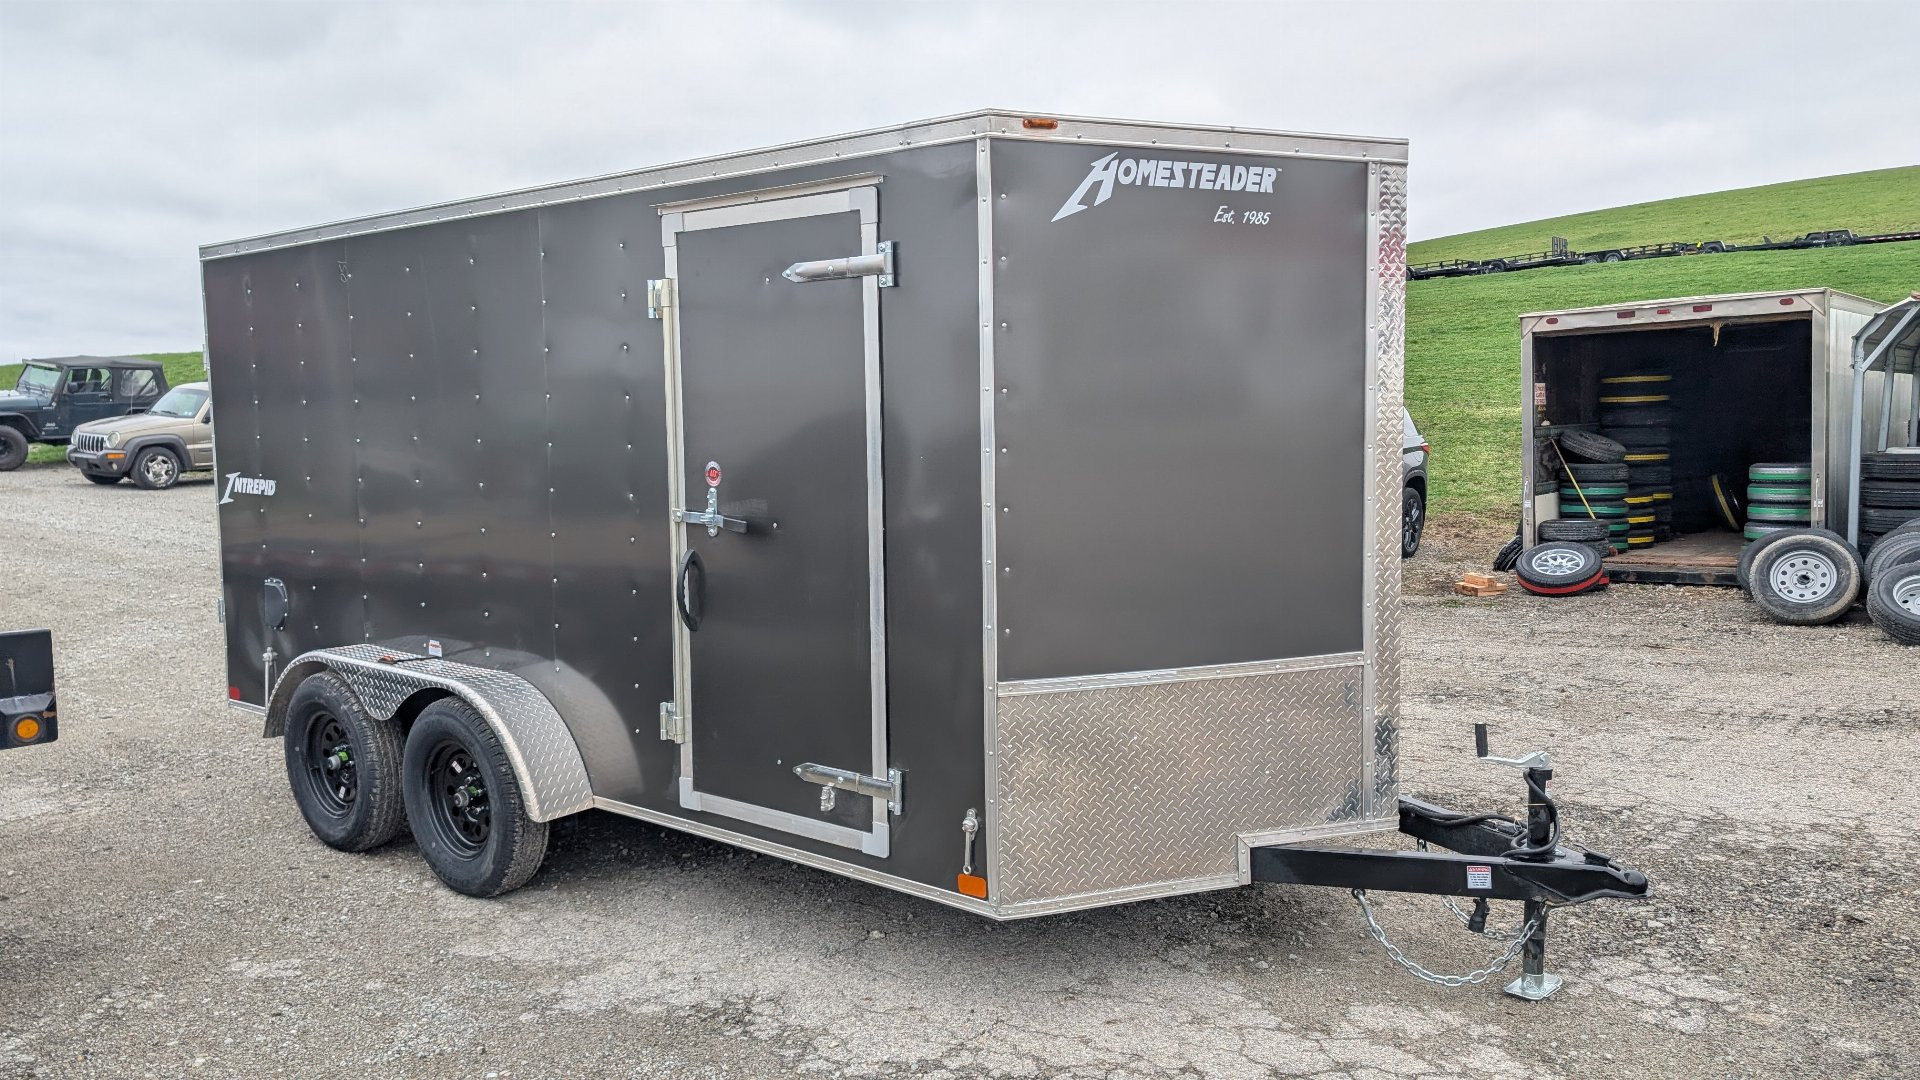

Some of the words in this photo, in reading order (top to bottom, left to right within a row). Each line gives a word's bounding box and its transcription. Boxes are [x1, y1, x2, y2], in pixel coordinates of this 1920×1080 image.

[1051, 152, 1277, 223] HOMESTEADER
[1243, 210, 1272, 225] 1985
[219, 471, 276, 504] INTREPID
